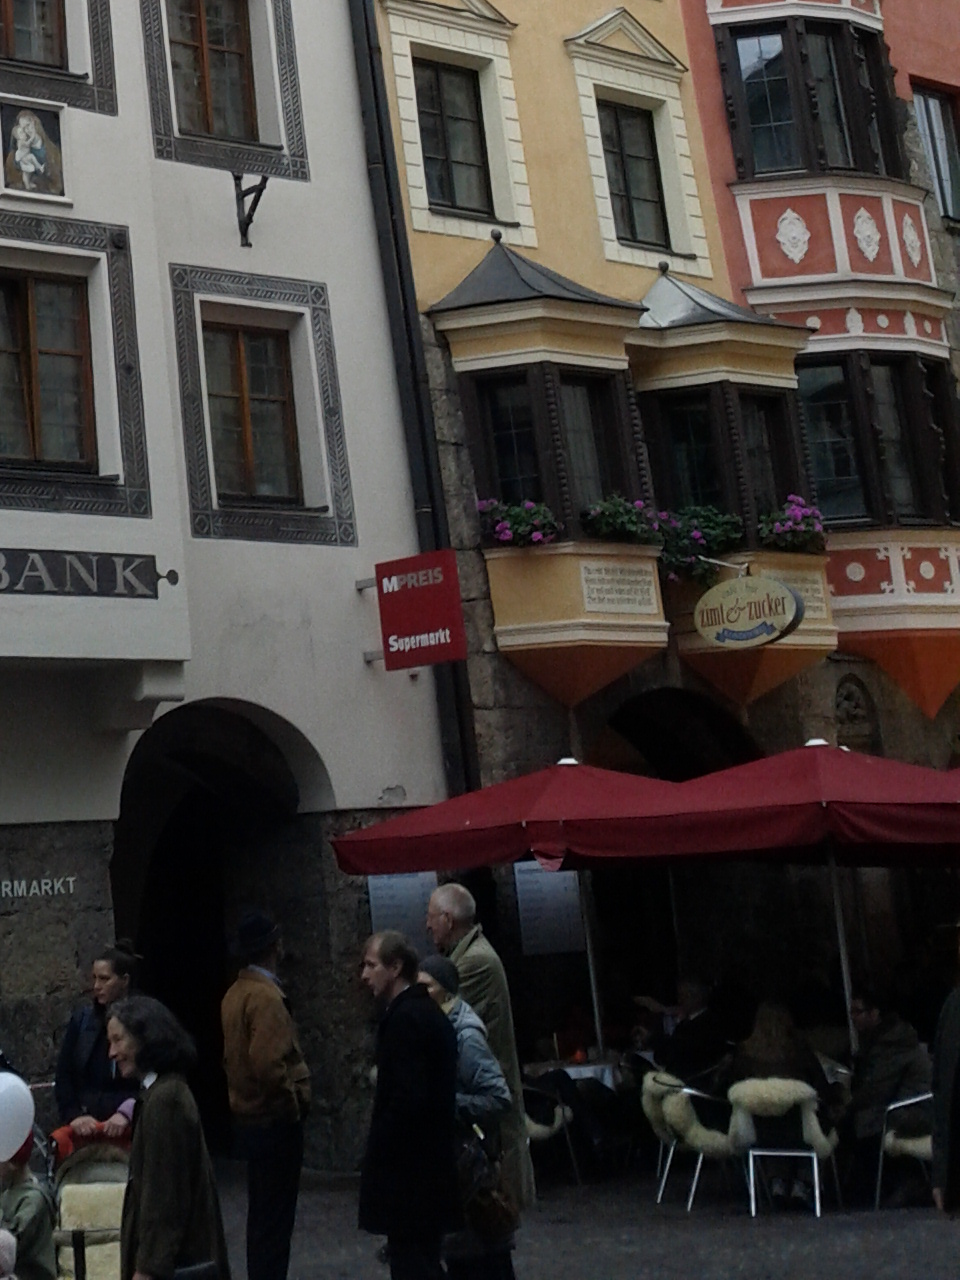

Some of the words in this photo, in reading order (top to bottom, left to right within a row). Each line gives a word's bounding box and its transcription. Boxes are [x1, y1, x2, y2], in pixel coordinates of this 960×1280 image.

[382, 567, 443, 594] MPREIS
[747, 592, 787, 621] zucker
[388, 628, 451, 653] Supermarkt
